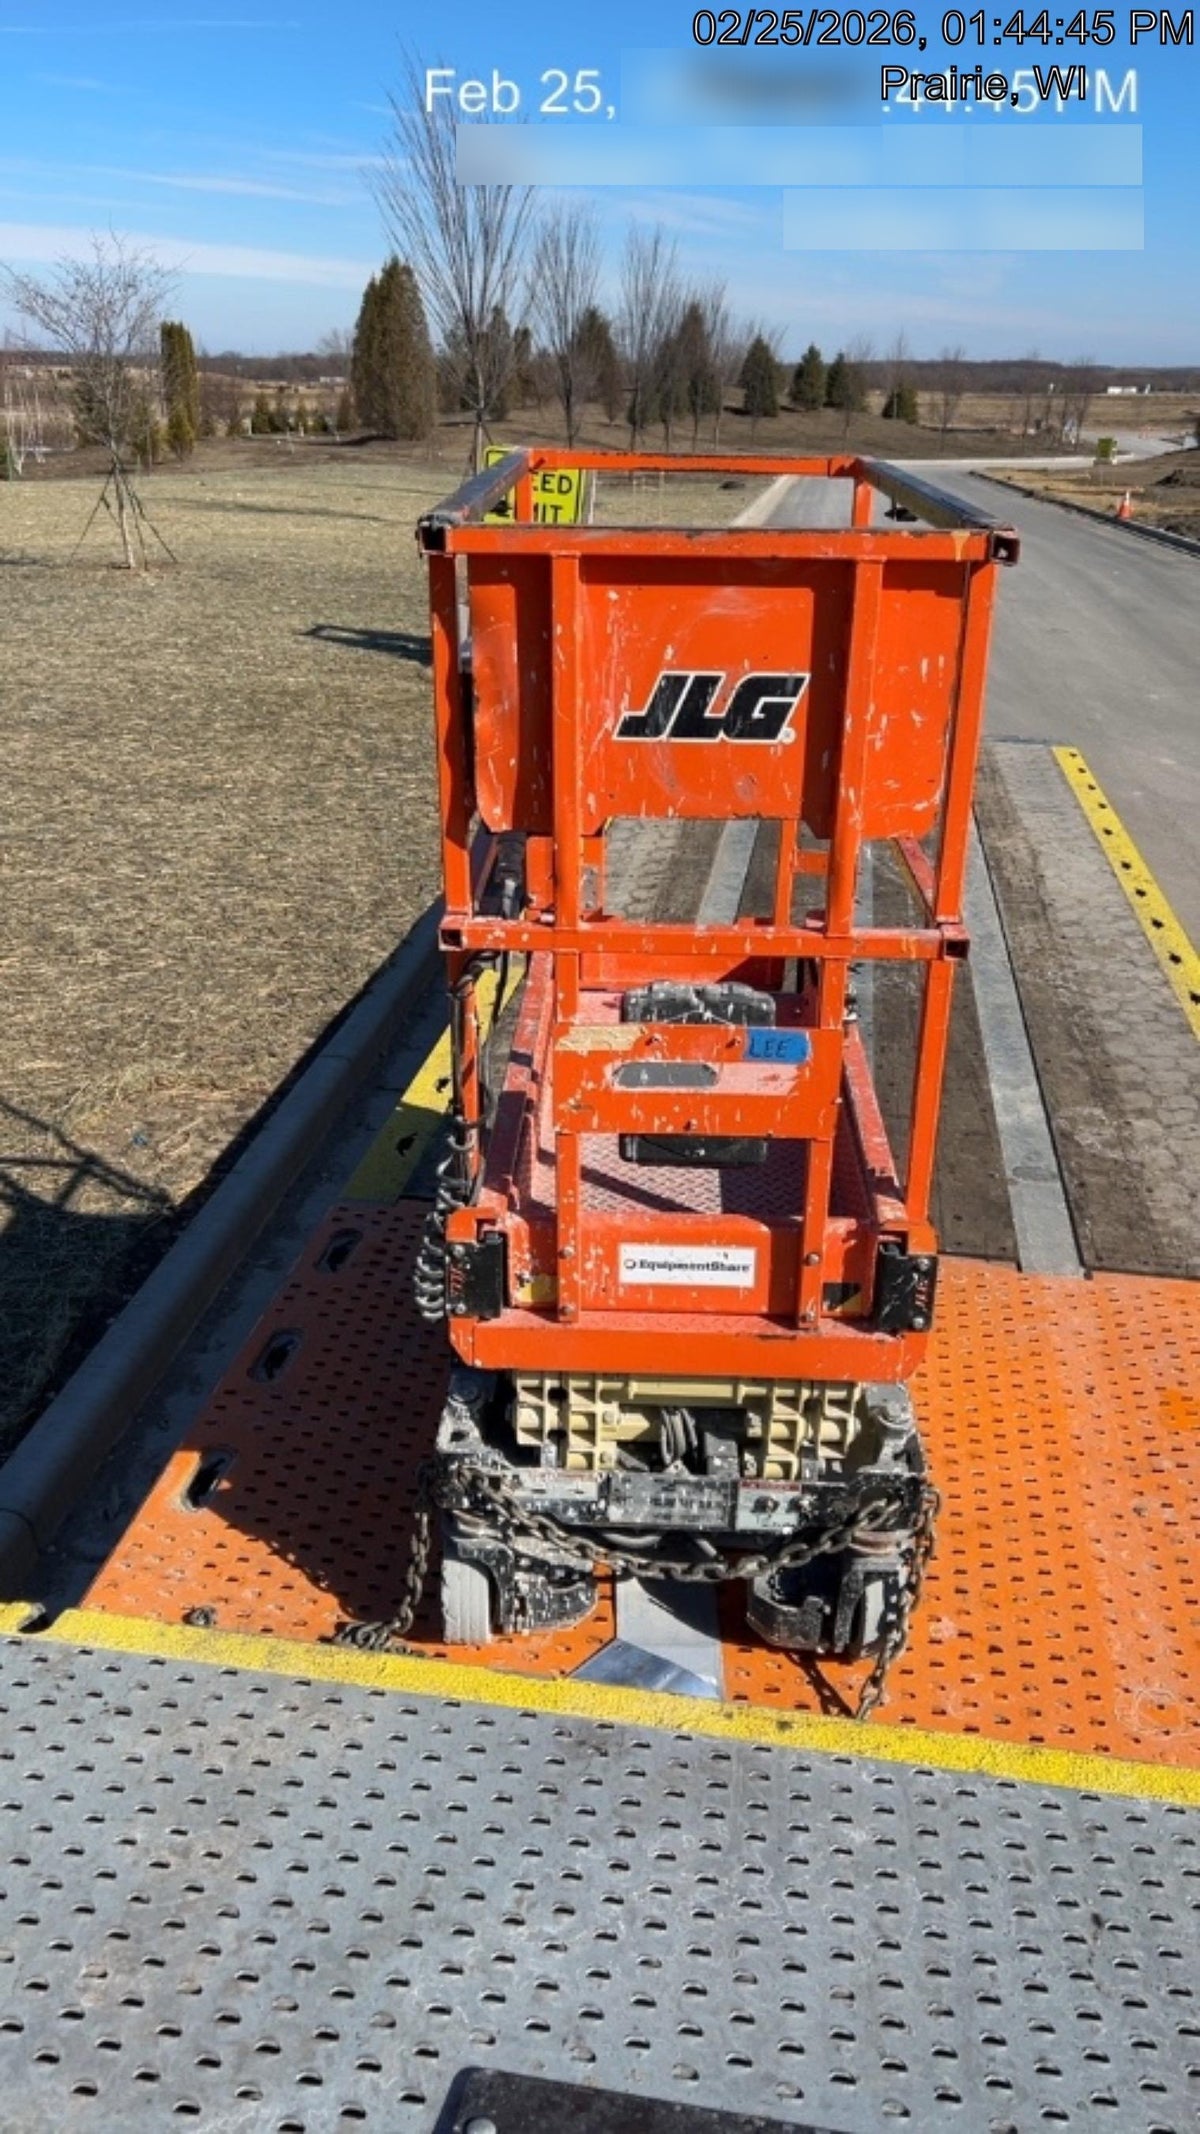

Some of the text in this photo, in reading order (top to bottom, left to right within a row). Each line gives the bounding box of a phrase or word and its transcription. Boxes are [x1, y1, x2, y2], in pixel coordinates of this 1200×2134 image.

[612, 670, 811, 744] JLG
[748, 1037, 793, 1058] LEE
[639, 1258, 751, 1273] EquipmentShare
